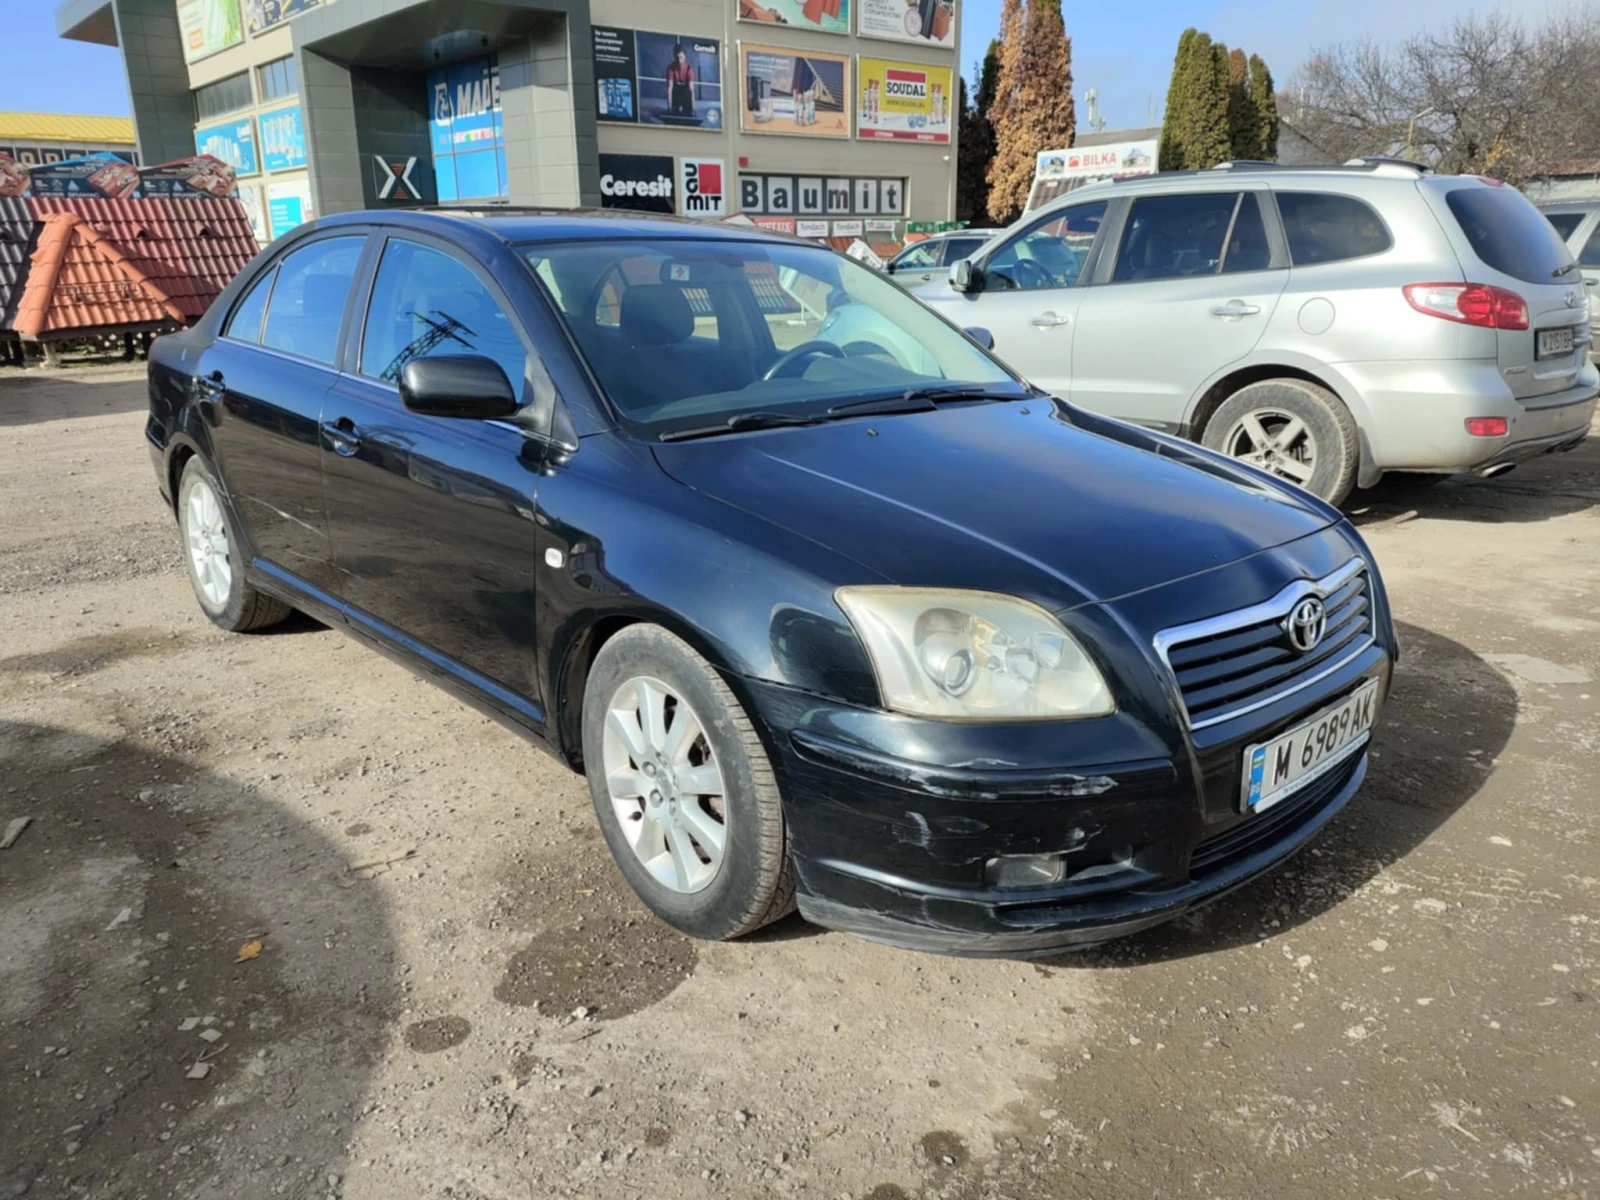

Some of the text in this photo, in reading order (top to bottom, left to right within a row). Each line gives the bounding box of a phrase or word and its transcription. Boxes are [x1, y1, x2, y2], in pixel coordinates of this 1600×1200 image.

[694, 43, 716, 53] Ceresit
[886, 82, 926, 97] SOUDAL
[1083, 152, 1118, 166] BILKA
[600, 174, 673, 197] Ceresit
[741, 180, 897, 210] Baumit
[800, 222, 826, 230] Tondach
[836, 222, 860, 230] Tondach
[1272, 739, 1293, 786] M
[1300, 707, 1351, 769] 6989
[1349, 688, 1374, 737] AK
